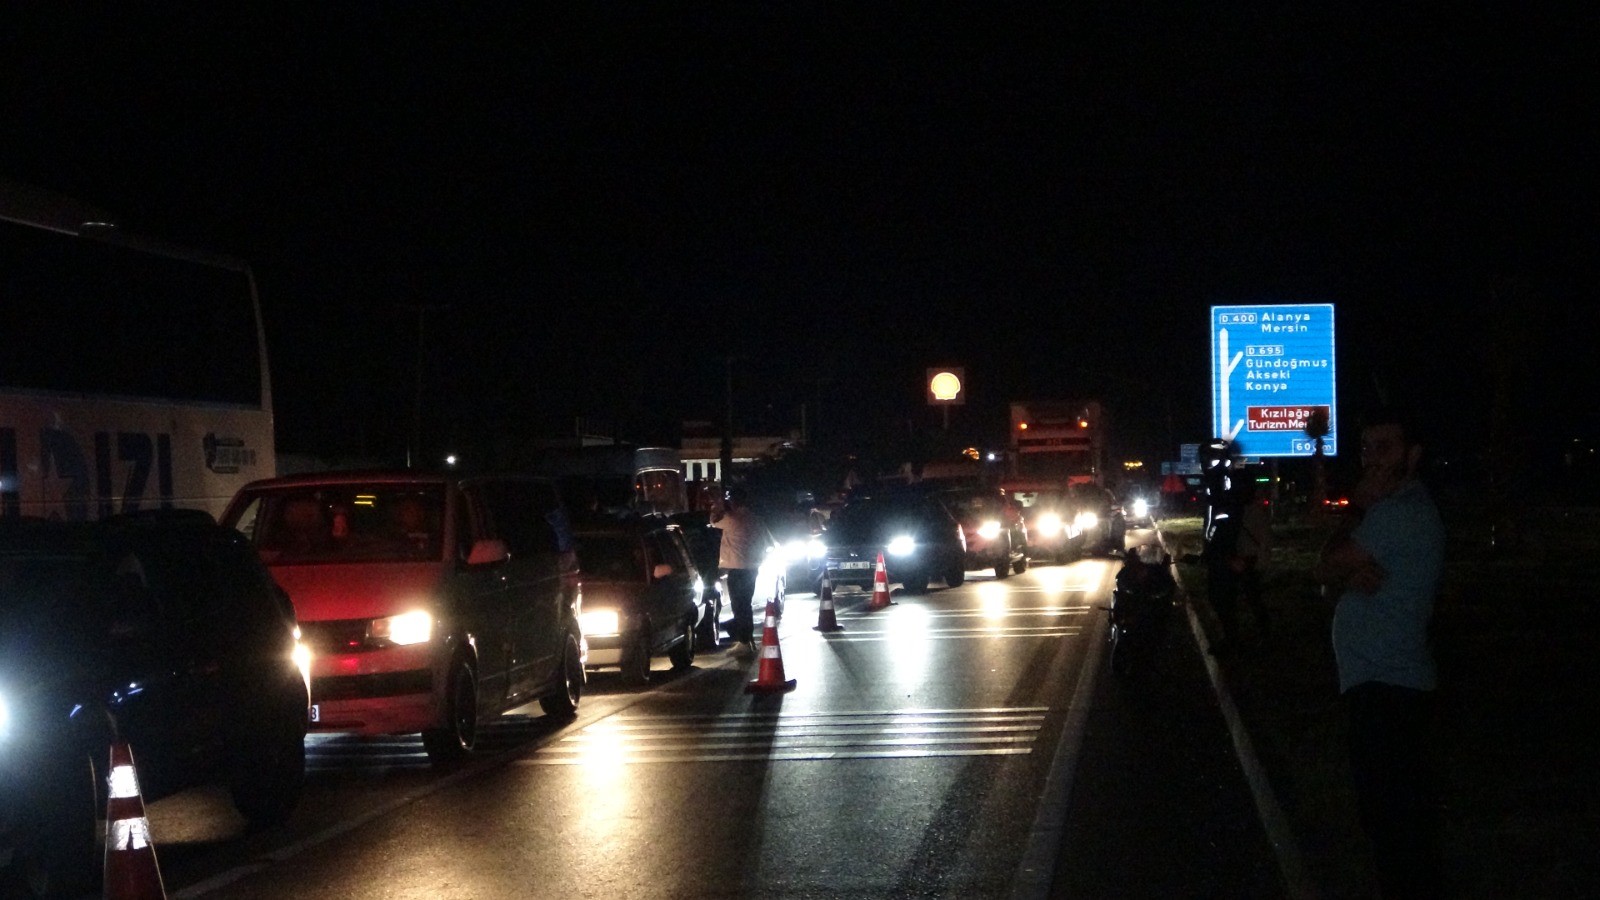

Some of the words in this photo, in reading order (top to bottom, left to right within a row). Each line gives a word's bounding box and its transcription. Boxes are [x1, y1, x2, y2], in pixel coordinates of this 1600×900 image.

[1261, 312, 1311, 324] Alanya
[1261, 323, 1308, 333] Mersin
[1246, 369, 1290, 379] Akseki
[1245, 381, 1287, 393] Konya
[1261, 408, 1315, 420] Kızılağa
[1249, 419, 1287, 429] Turizm
